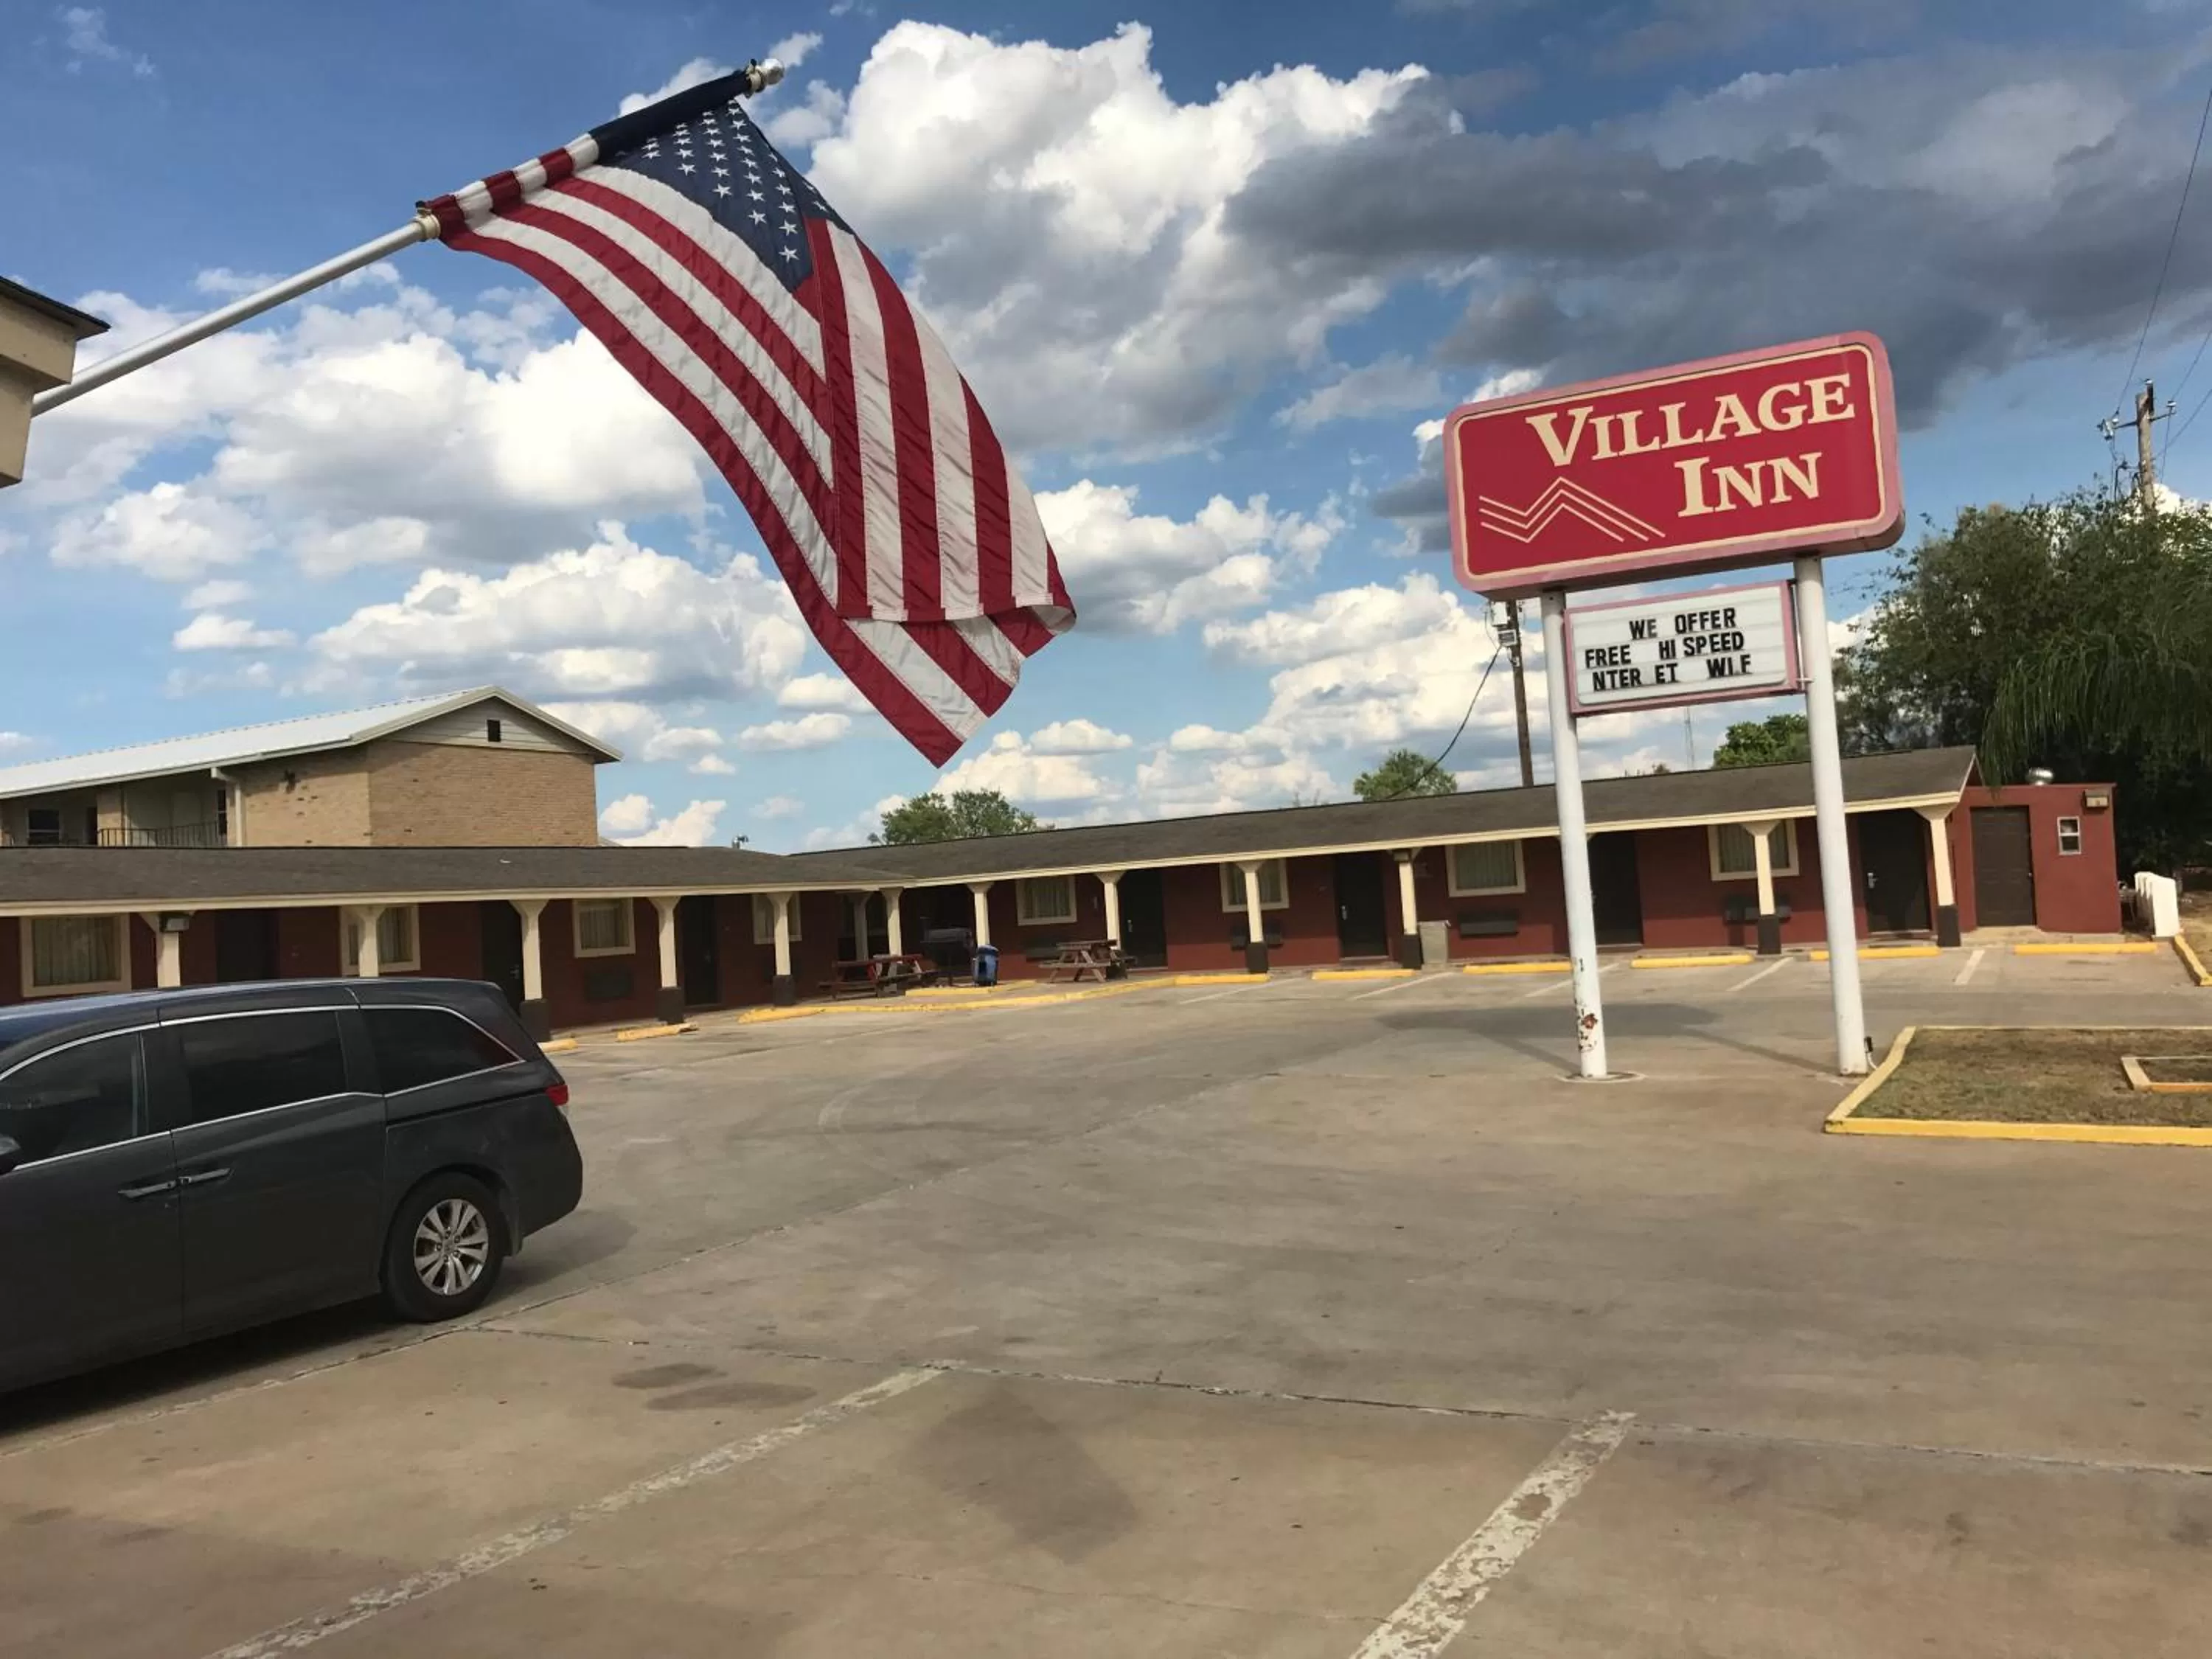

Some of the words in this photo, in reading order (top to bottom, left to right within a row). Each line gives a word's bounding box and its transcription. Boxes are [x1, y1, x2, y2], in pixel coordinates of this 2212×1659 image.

[1629, 619, 1658, 640] WE
[1674, 607, 1736, 635] OFFER
[1585, 644, 1632, 669] FREE
[1683, 631, 1744, 657] SPEED
